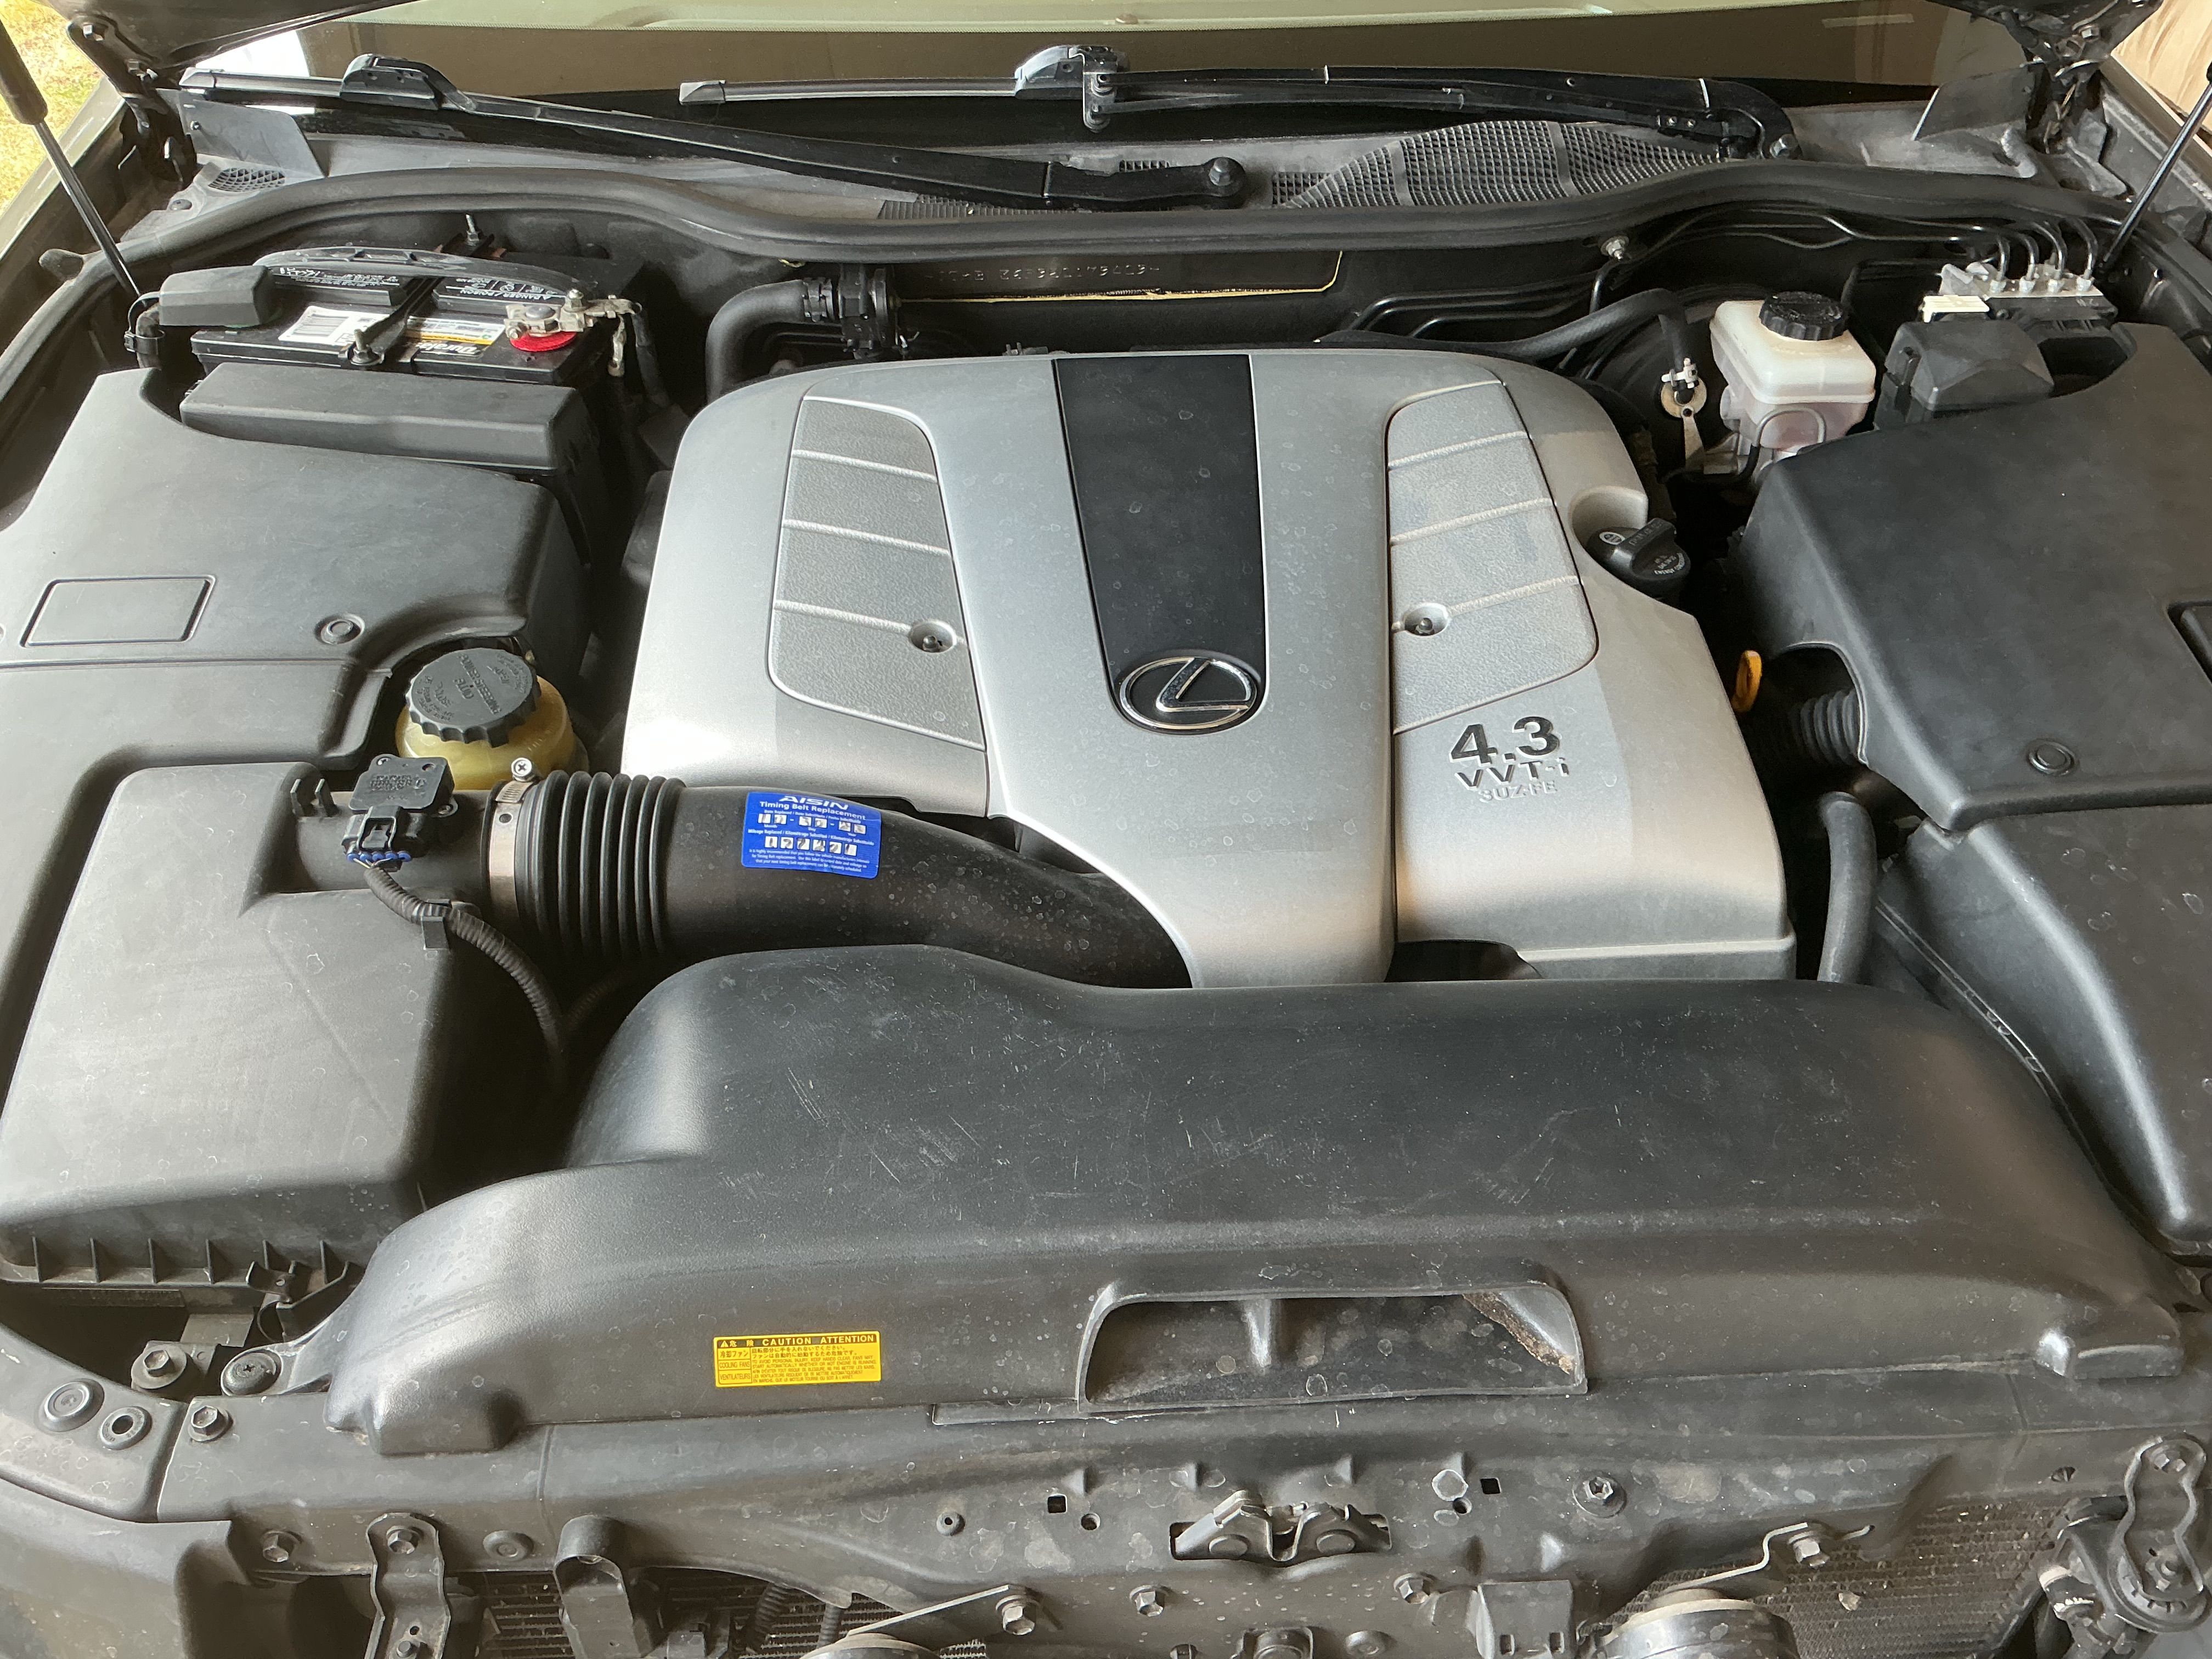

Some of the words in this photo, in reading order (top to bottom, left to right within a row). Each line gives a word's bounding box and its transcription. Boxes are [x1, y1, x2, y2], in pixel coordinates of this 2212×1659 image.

[1449, 716, 1560, 766] 4.3
[779, 795, 849, 810] AISIN
[760, 802, 789, 810] Timing
[811, 806, 866, 821] Replacement
[762, 1338, 811, 1346] CAUTION
[820, 1334, 874, 1344] ATTENTION
